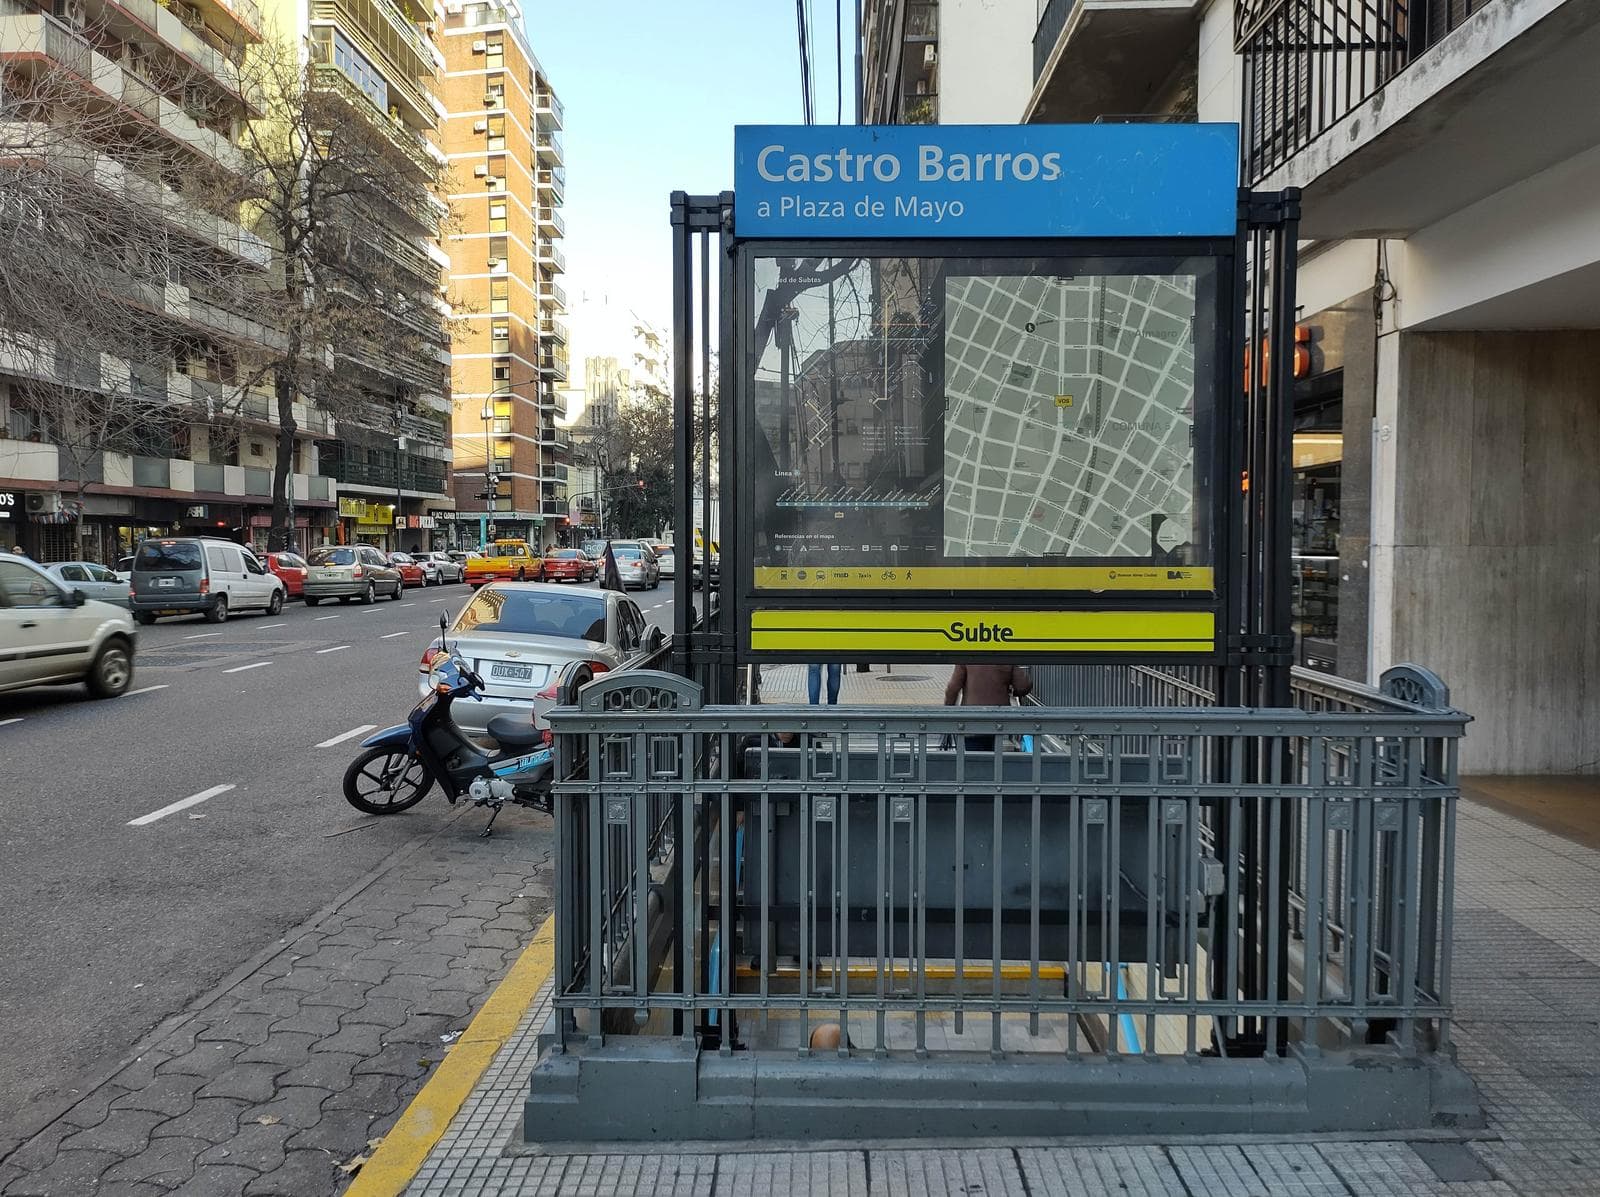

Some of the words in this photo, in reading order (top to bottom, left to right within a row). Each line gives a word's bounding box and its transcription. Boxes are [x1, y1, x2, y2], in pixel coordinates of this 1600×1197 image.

[757, 145, 900, 183] Castro
[918, 145, 1061, 182] Barros
[757, 201, 770, 217] a
[780, 196, 845, 217] Plaza
[854, 196, 885, 217] de
[895, 196, 964, 223] Mayo
[950, 621, 1014, 643] Subte
